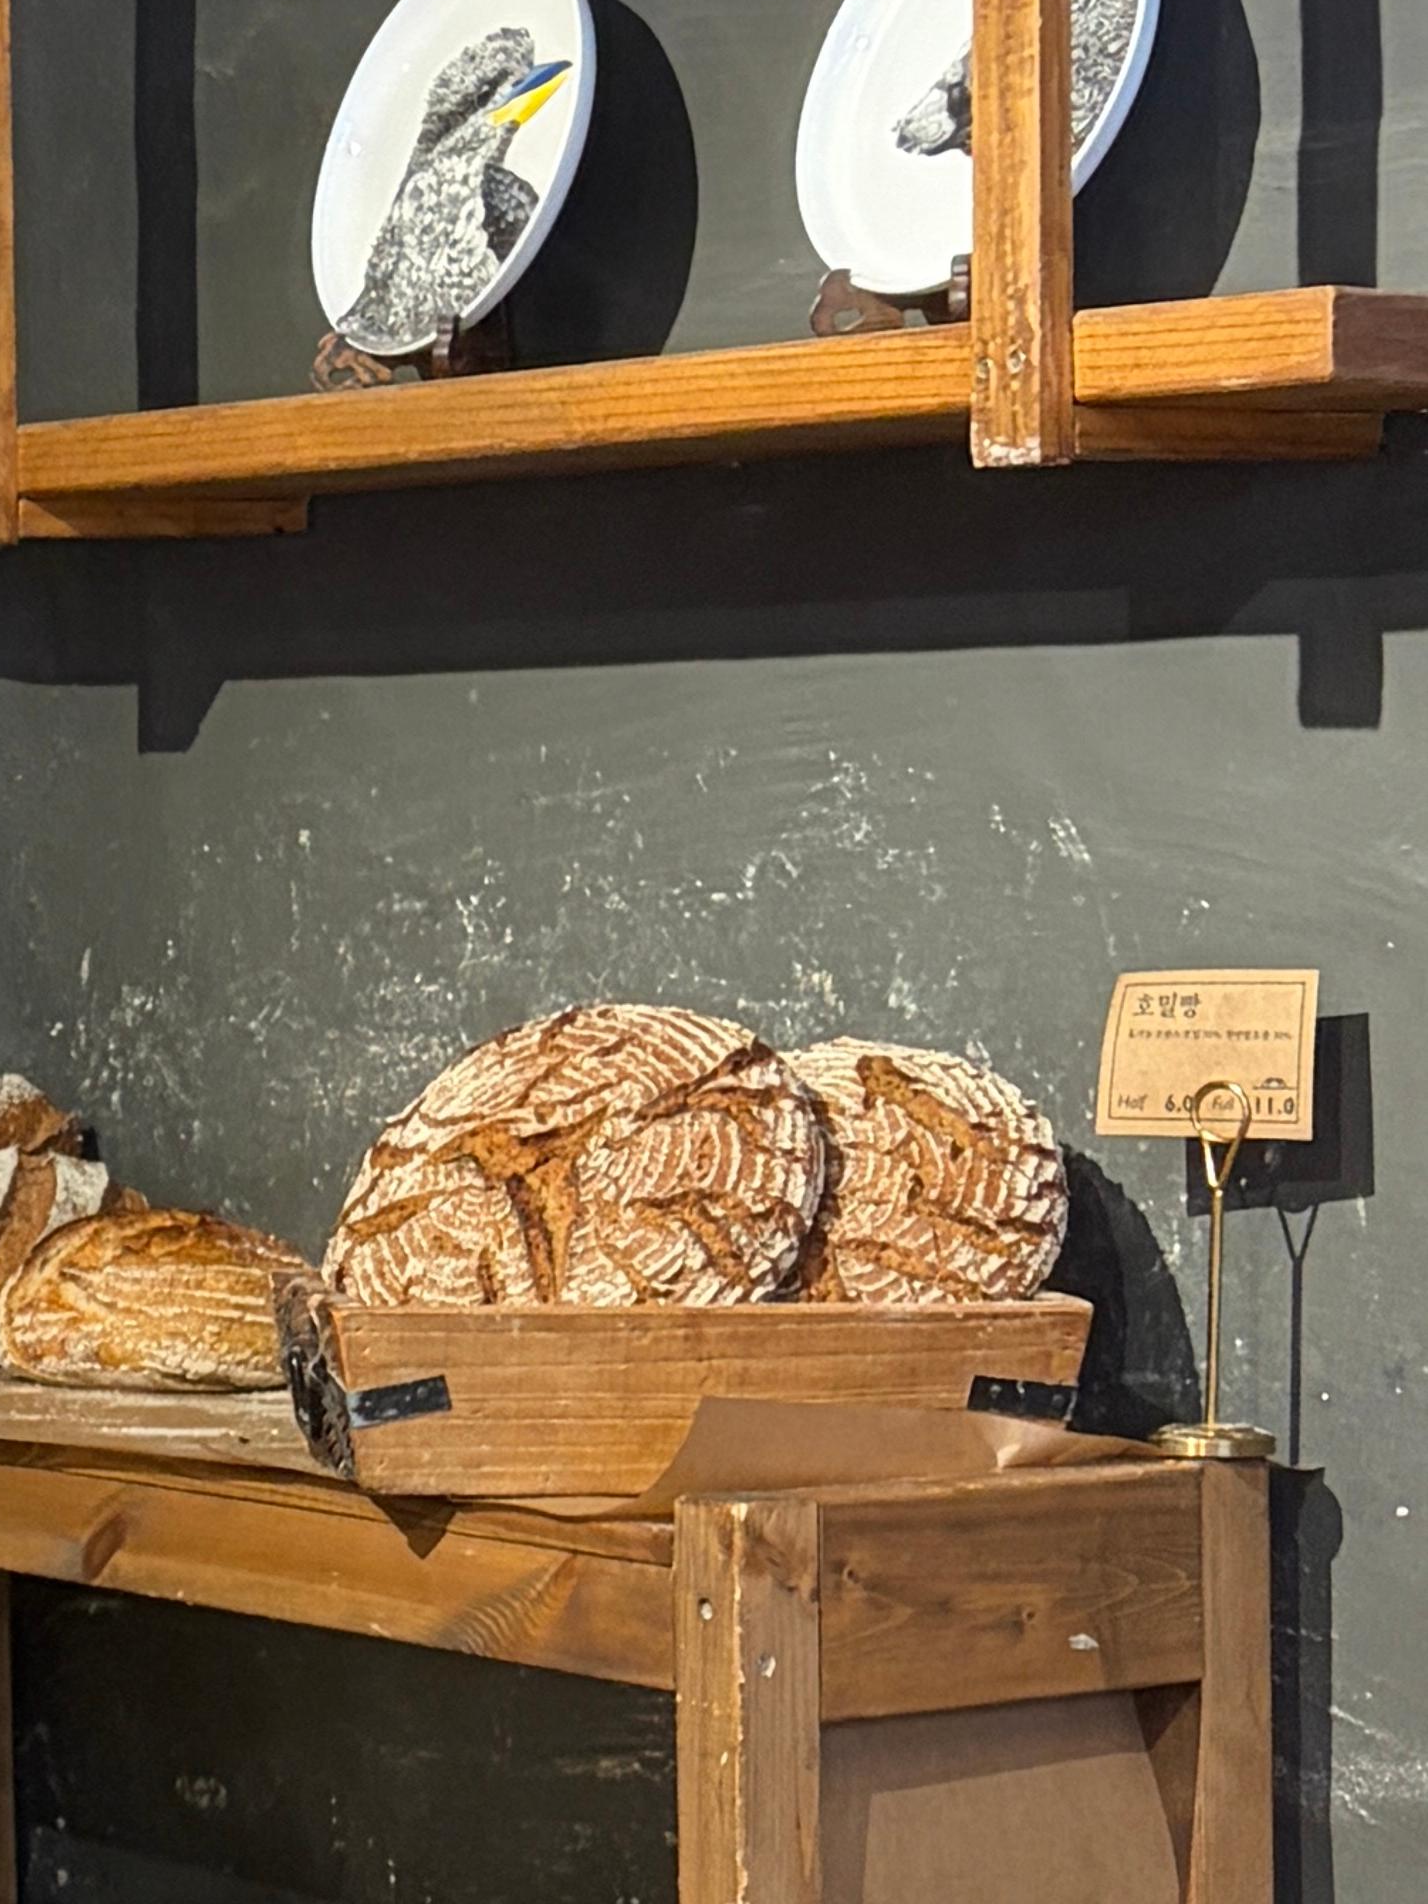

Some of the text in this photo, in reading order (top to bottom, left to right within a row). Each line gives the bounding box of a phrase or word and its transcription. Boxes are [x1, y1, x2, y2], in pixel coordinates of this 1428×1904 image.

[1132, 991, 1202, 1019] 호밀빵
[1164, 1095, 1192, 1113] 6.0
[1254, 1096, 1295, 1115] 11.0
